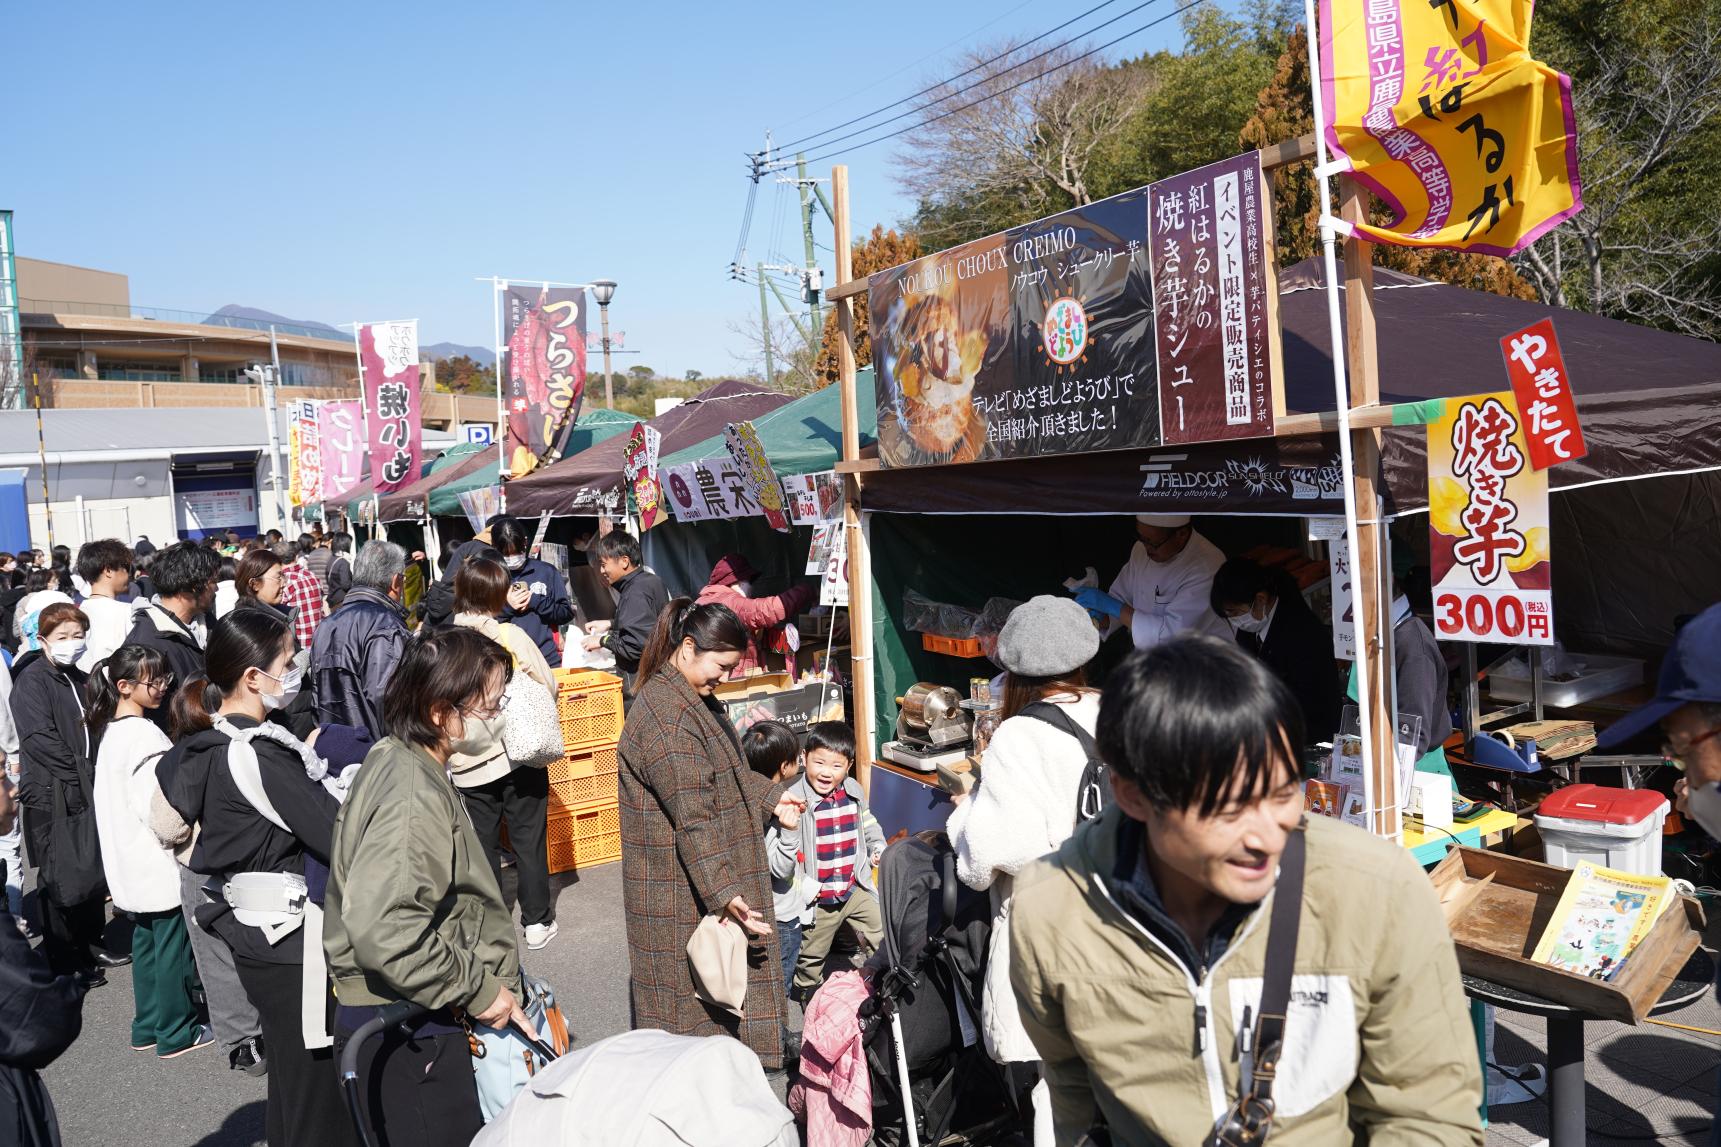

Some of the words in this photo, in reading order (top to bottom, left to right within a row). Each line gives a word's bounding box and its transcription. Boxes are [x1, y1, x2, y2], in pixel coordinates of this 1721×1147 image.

[957, 246, 1008, 280] CHOUX
[1013, 226, 1076, 264] CREIMO
[1010, 265, 1048, 293] ノウコウ
[1057, 239, 1141, 280] シュークリー芋
[1188, 182, 1215, 329] 紅はるかの
[1156, 191, 1193, 431] 焼き芋シュー
[1219, 181, 1247, 419] イベント限定販売商品
[972, 373, 1135, 416] テレビ「めざましどようび」で
[1510, 333, 1571, 459] やきたて
[1139, 489, 1170, 498] Powered
[1173, 489, 1182, 499] by
[1453, 400, 1525, 584] 焼き芋
[1436, 593, 1525, 638] 300
[773, 711, 808, 723] つまいも
